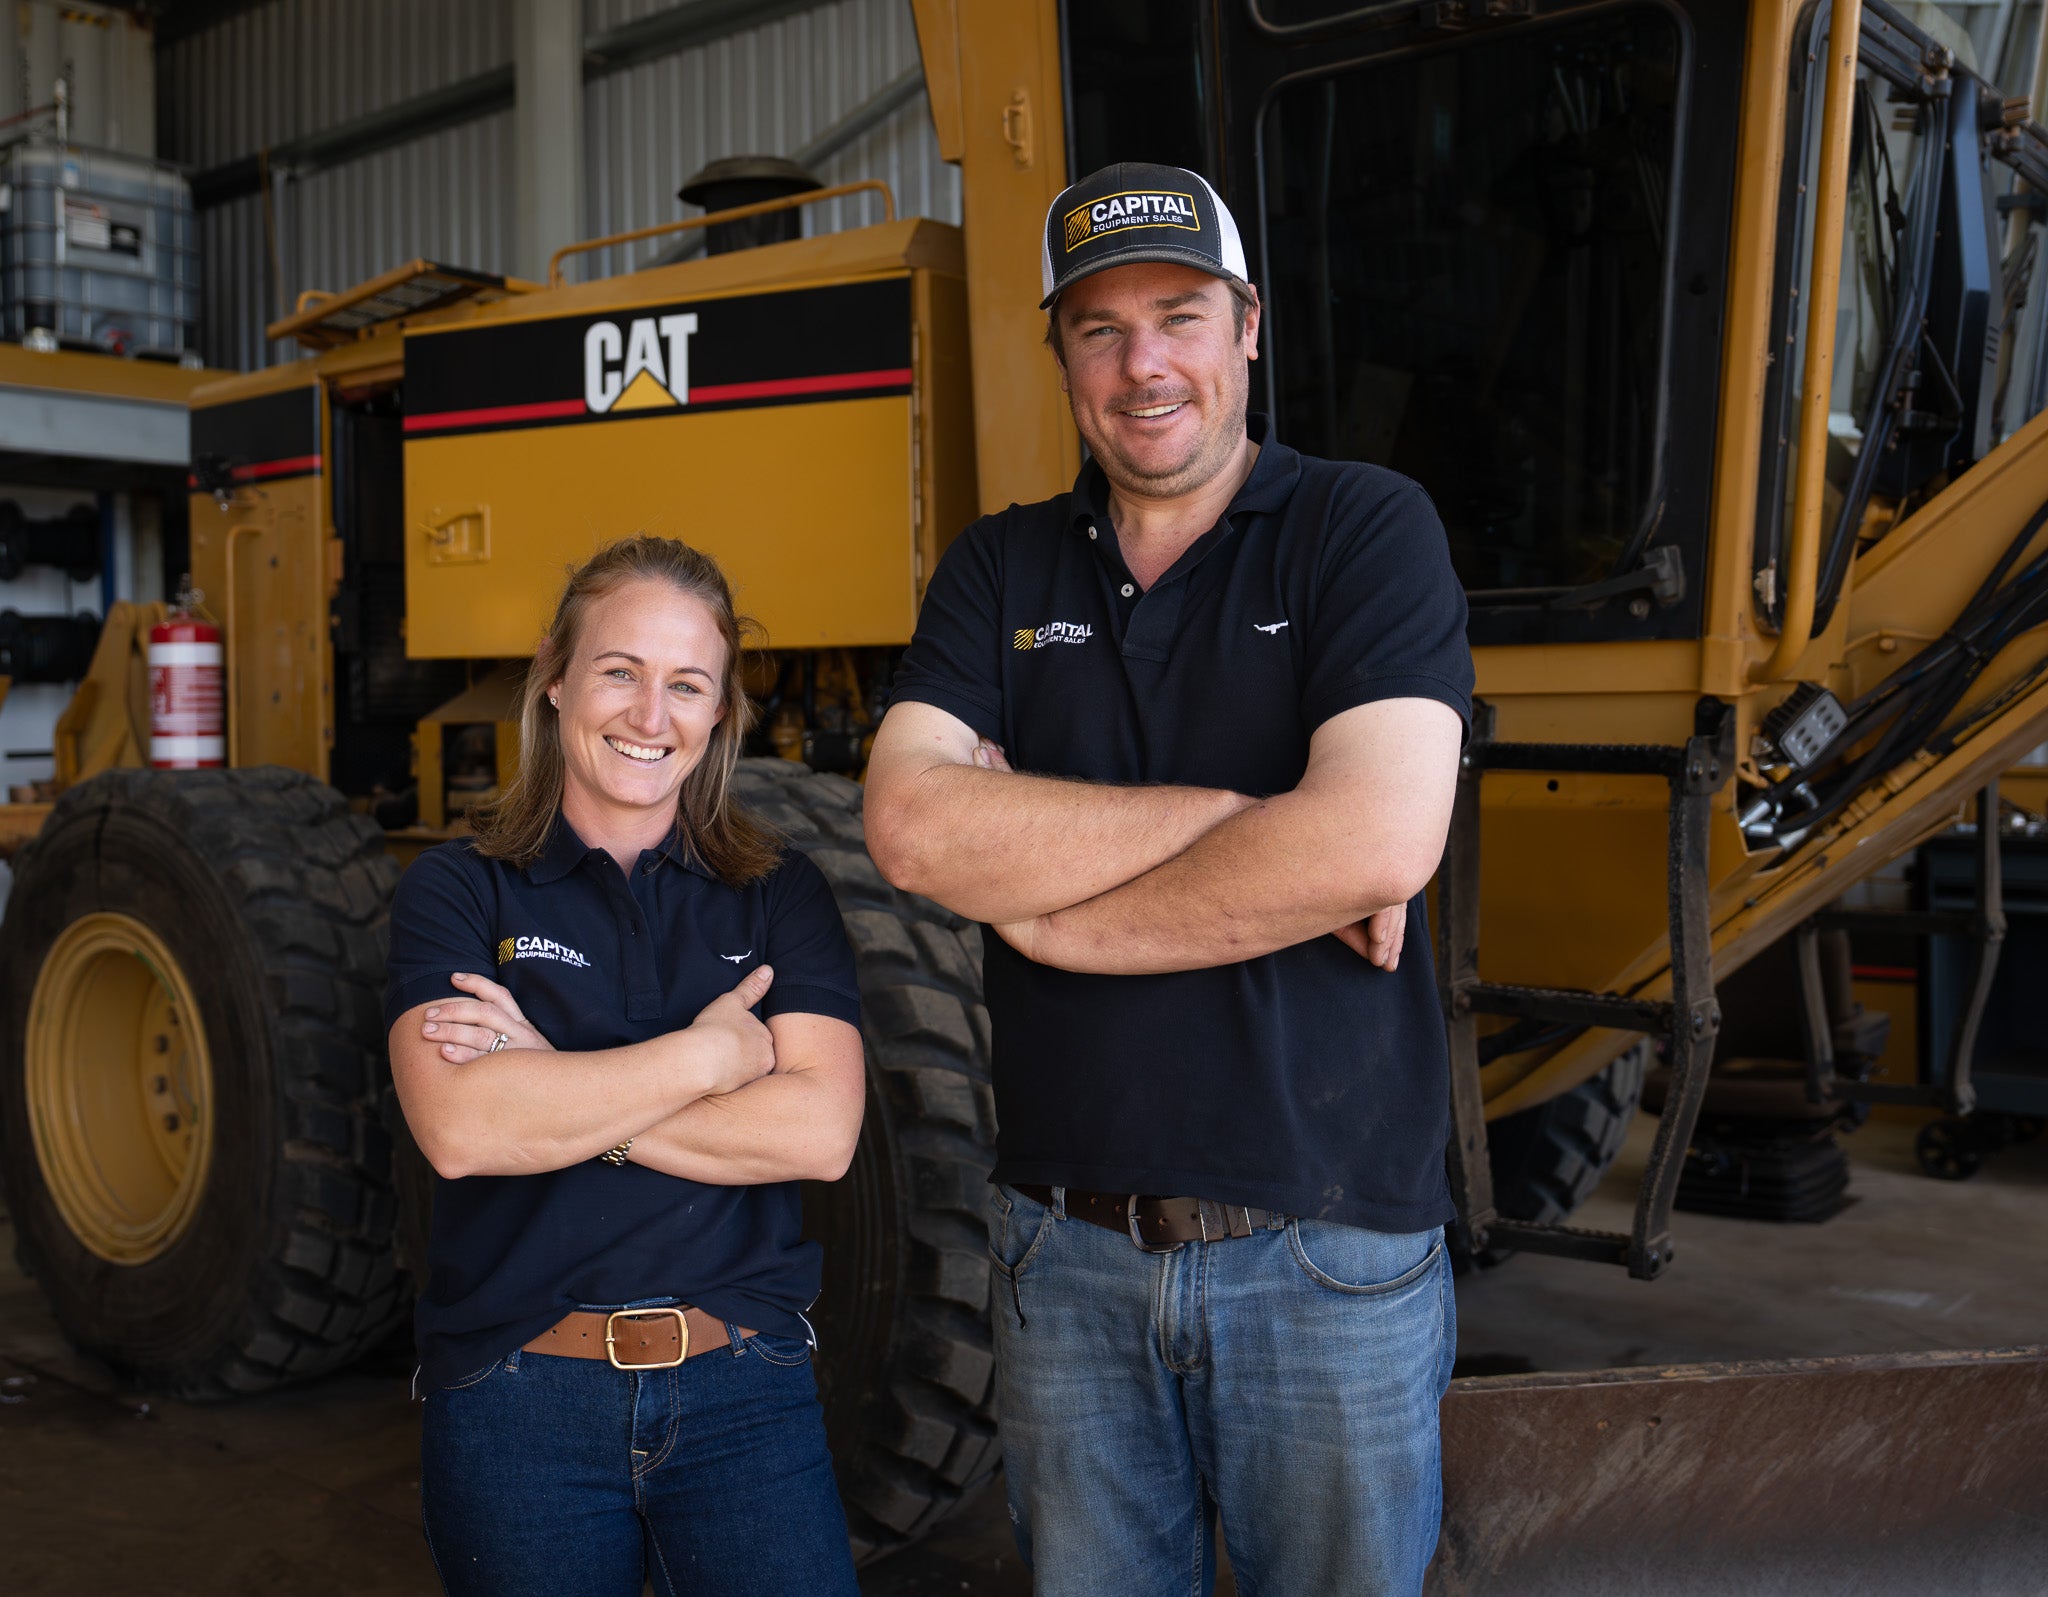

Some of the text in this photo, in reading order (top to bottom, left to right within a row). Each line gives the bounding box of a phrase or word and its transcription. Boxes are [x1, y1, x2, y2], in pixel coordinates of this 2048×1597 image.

[1091, 195, 1193, 222] CAPITAL
[1093, 214, 1183, 233] EQUIPMENT SALES
[584, 312, 698, 413] CAT
[1035, 622, 1094, 641] CAPITAL
[1034, 635, 1063, 648] EQUENT
[516, 936, 591, 967] CAPITAL
[516, 951, 583, 968] EQUIPMENT SALES
